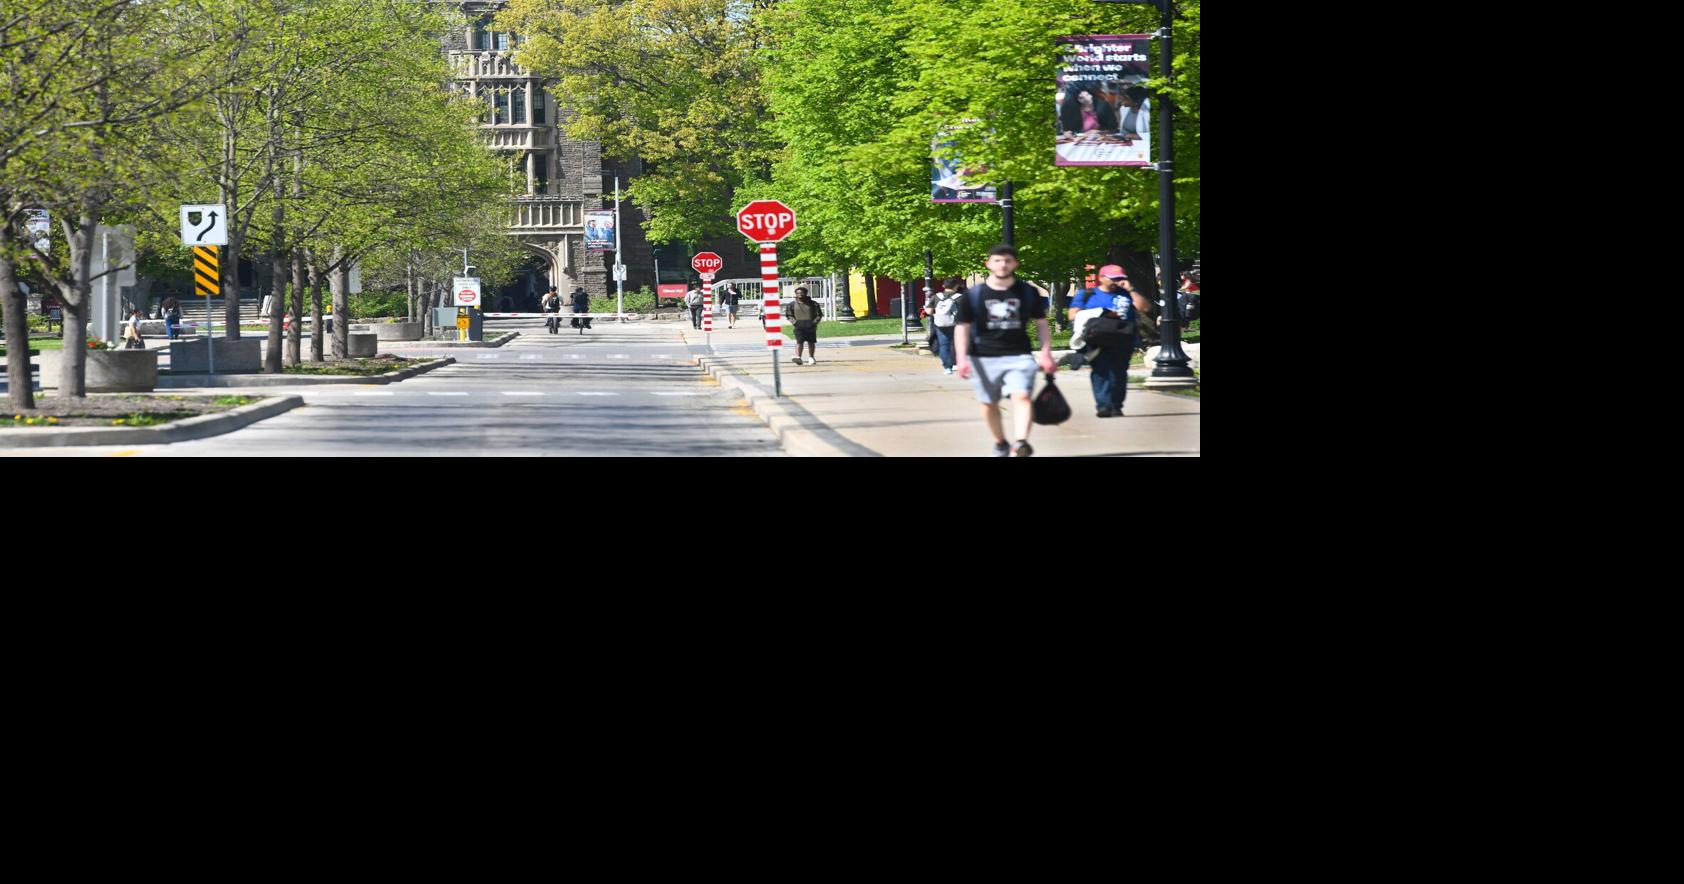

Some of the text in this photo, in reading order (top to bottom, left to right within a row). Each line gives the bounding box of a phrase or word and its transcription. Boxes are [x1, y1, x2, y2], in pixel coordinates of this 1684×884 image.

[1105, 53, 1147, 62] starts
[1063, 63, 1123, 72] when we
[1062, 72, 1119, 81] connect
[741, 213, 792, 230] STOP
[694, 258, 721, 268] STOP
